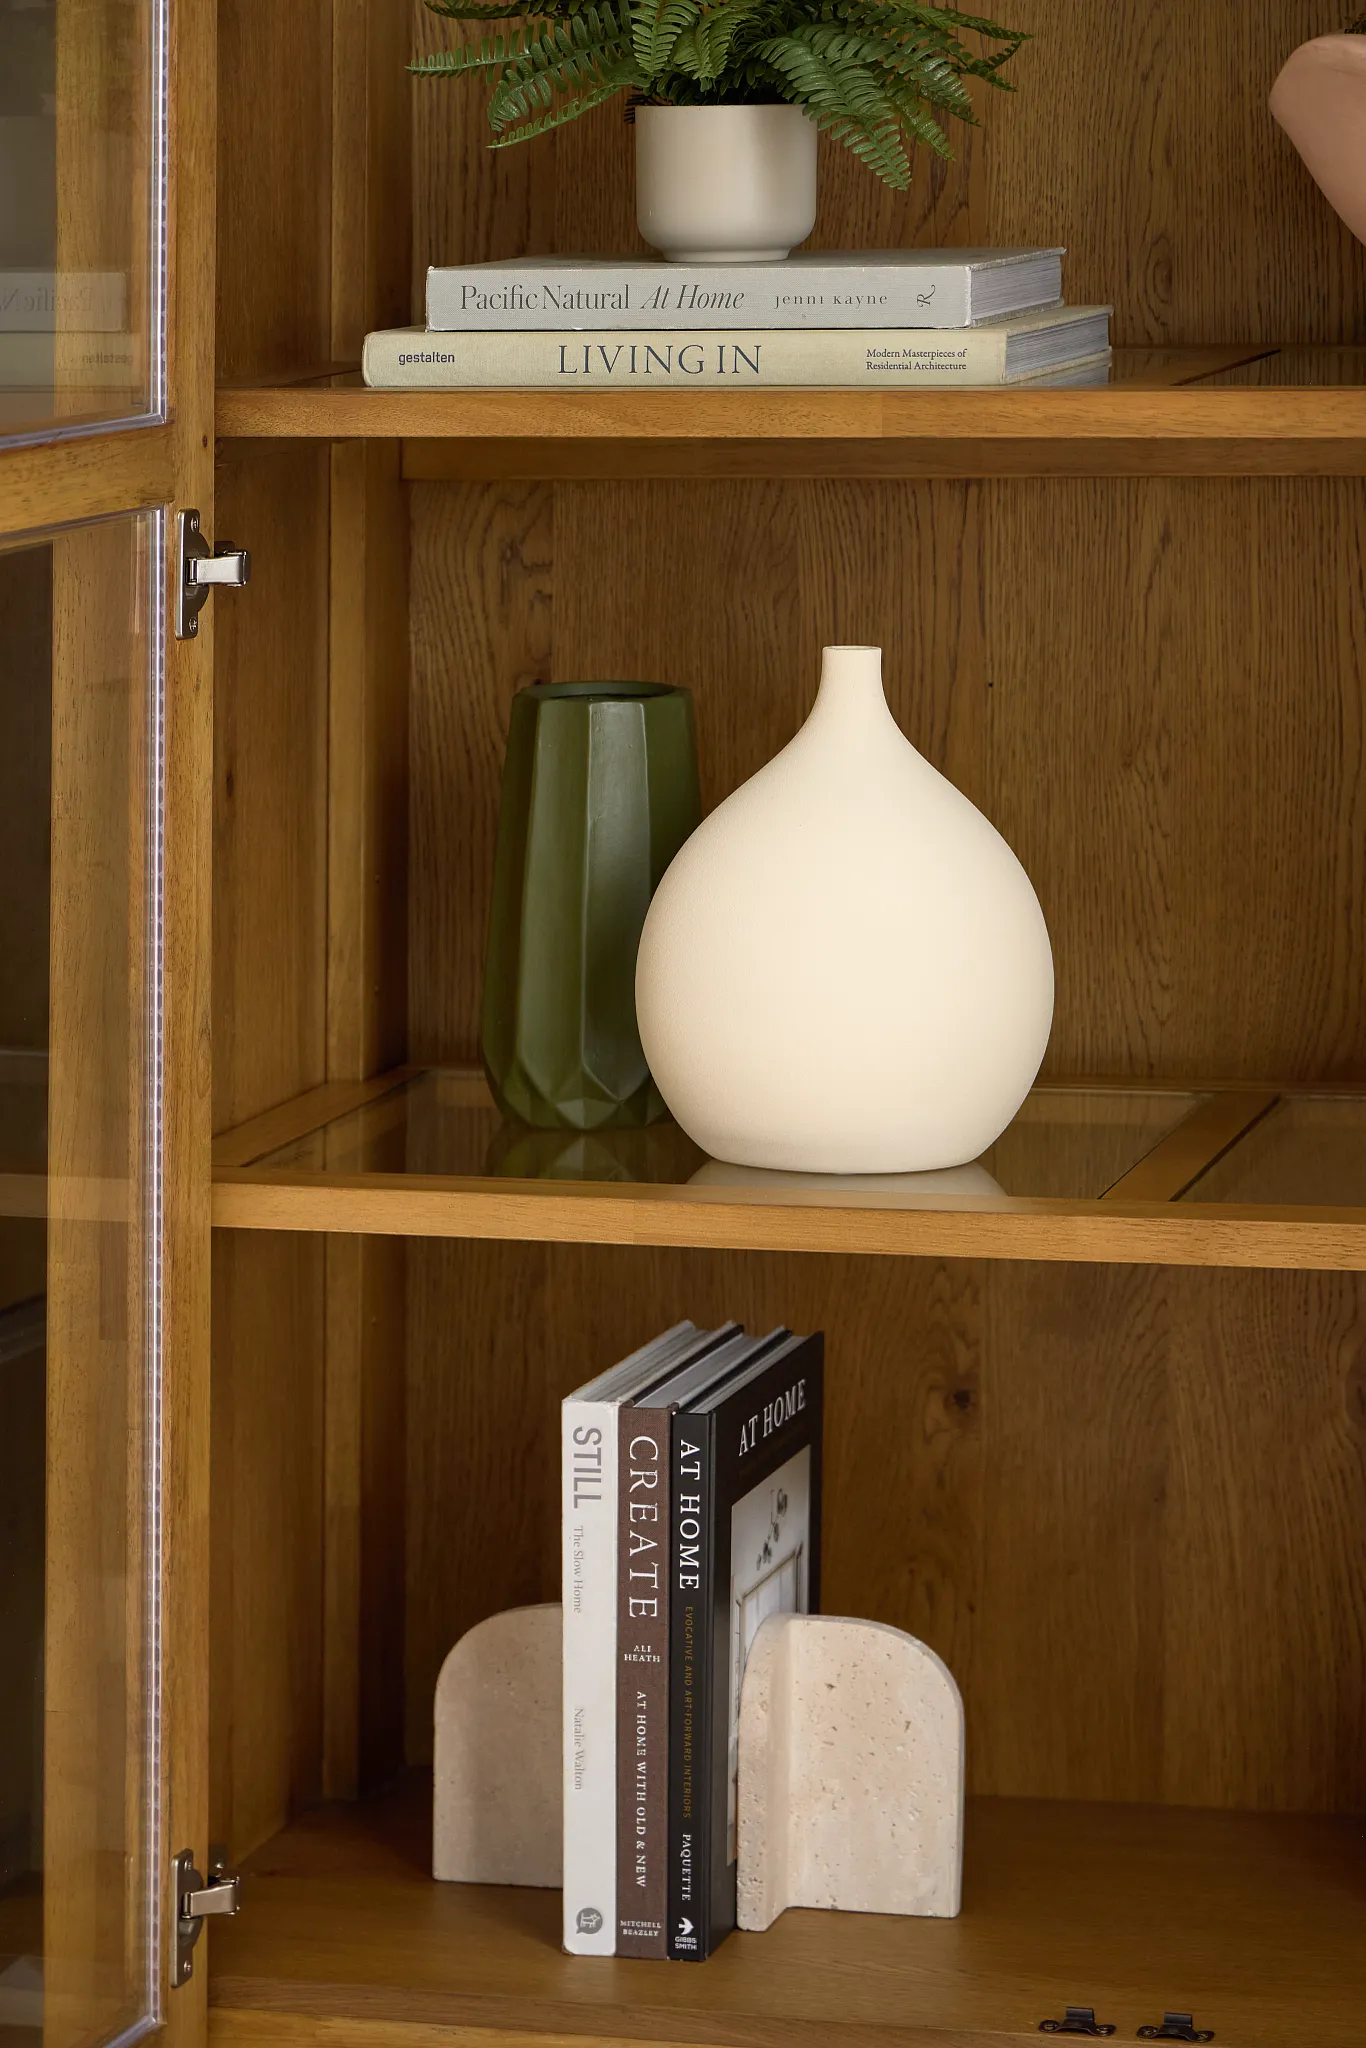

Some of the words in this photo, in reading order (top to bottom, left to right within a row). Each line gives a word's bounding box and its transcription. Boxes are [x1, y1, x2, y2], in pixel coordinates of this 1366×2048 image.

[460, 284, 538, 310] Pacific
[542, 284, 630, 310] Natural
[639, 285, 670, 310] At
[676, 285, 745, 310] Home
[398, 352, 456, 366] gestalten
[557, 344, 705, 375] LIVING
[717, 344, 762, 375] IN
[866, 348, 901, 359] Modern
[902, 348, 956, 361] Masterpieces
[957, 348, 967, 359] of
[866, 361, 912, 371] Residential
[914, 361, 967, 371] Architecture
[738, 1414, 758, 1457] AT
[762, 1378, 806, 1438] HOME
[572, 1426, 602, 1509] STILL
[680, 1439, 701, 1481] AT
[573, 1525, 584, 1548] The
[628, 1435, 659, 1618] CREATE
[679, 1494, 700, 1590] HOME
[573, 1550, 584, 1577] Slow
[573, 1580, 584, 1614] Home
[633, 1644, 652, 1653] ALI
[684, 1606, 693, 1661] EVOCATIVE
[624, 1653, 661, 1663] HEATH
[684, 1665, 693, 1686] AND
[636, 1691, 647, 1709] AT
[574, 1708, 585, 1748] Natalie
[636, 1714, 646, 1756] HOME
[683, 1690, 692, 1762] ART-FORWARD
[574, 1750, 585, 1790] Walton
[636, 1761, 646, 1801] WITH
[683, 1765, 692, 1818] INTERIORS
[636, 1806, 646, 1835] OLD
[636, 1840, 646, 1850] &
[635, 1855, 646, 1888] NEW
[680, 1833, 692, 1901] PAQUETTE
[620, 1920, 662, 1929] MITCHELL
[622, 1928, 659, 1937] BEAZLEY
[674, 1936, 698, 1944] GIBBS
[674, 1943, 698, 1951] SMITH
